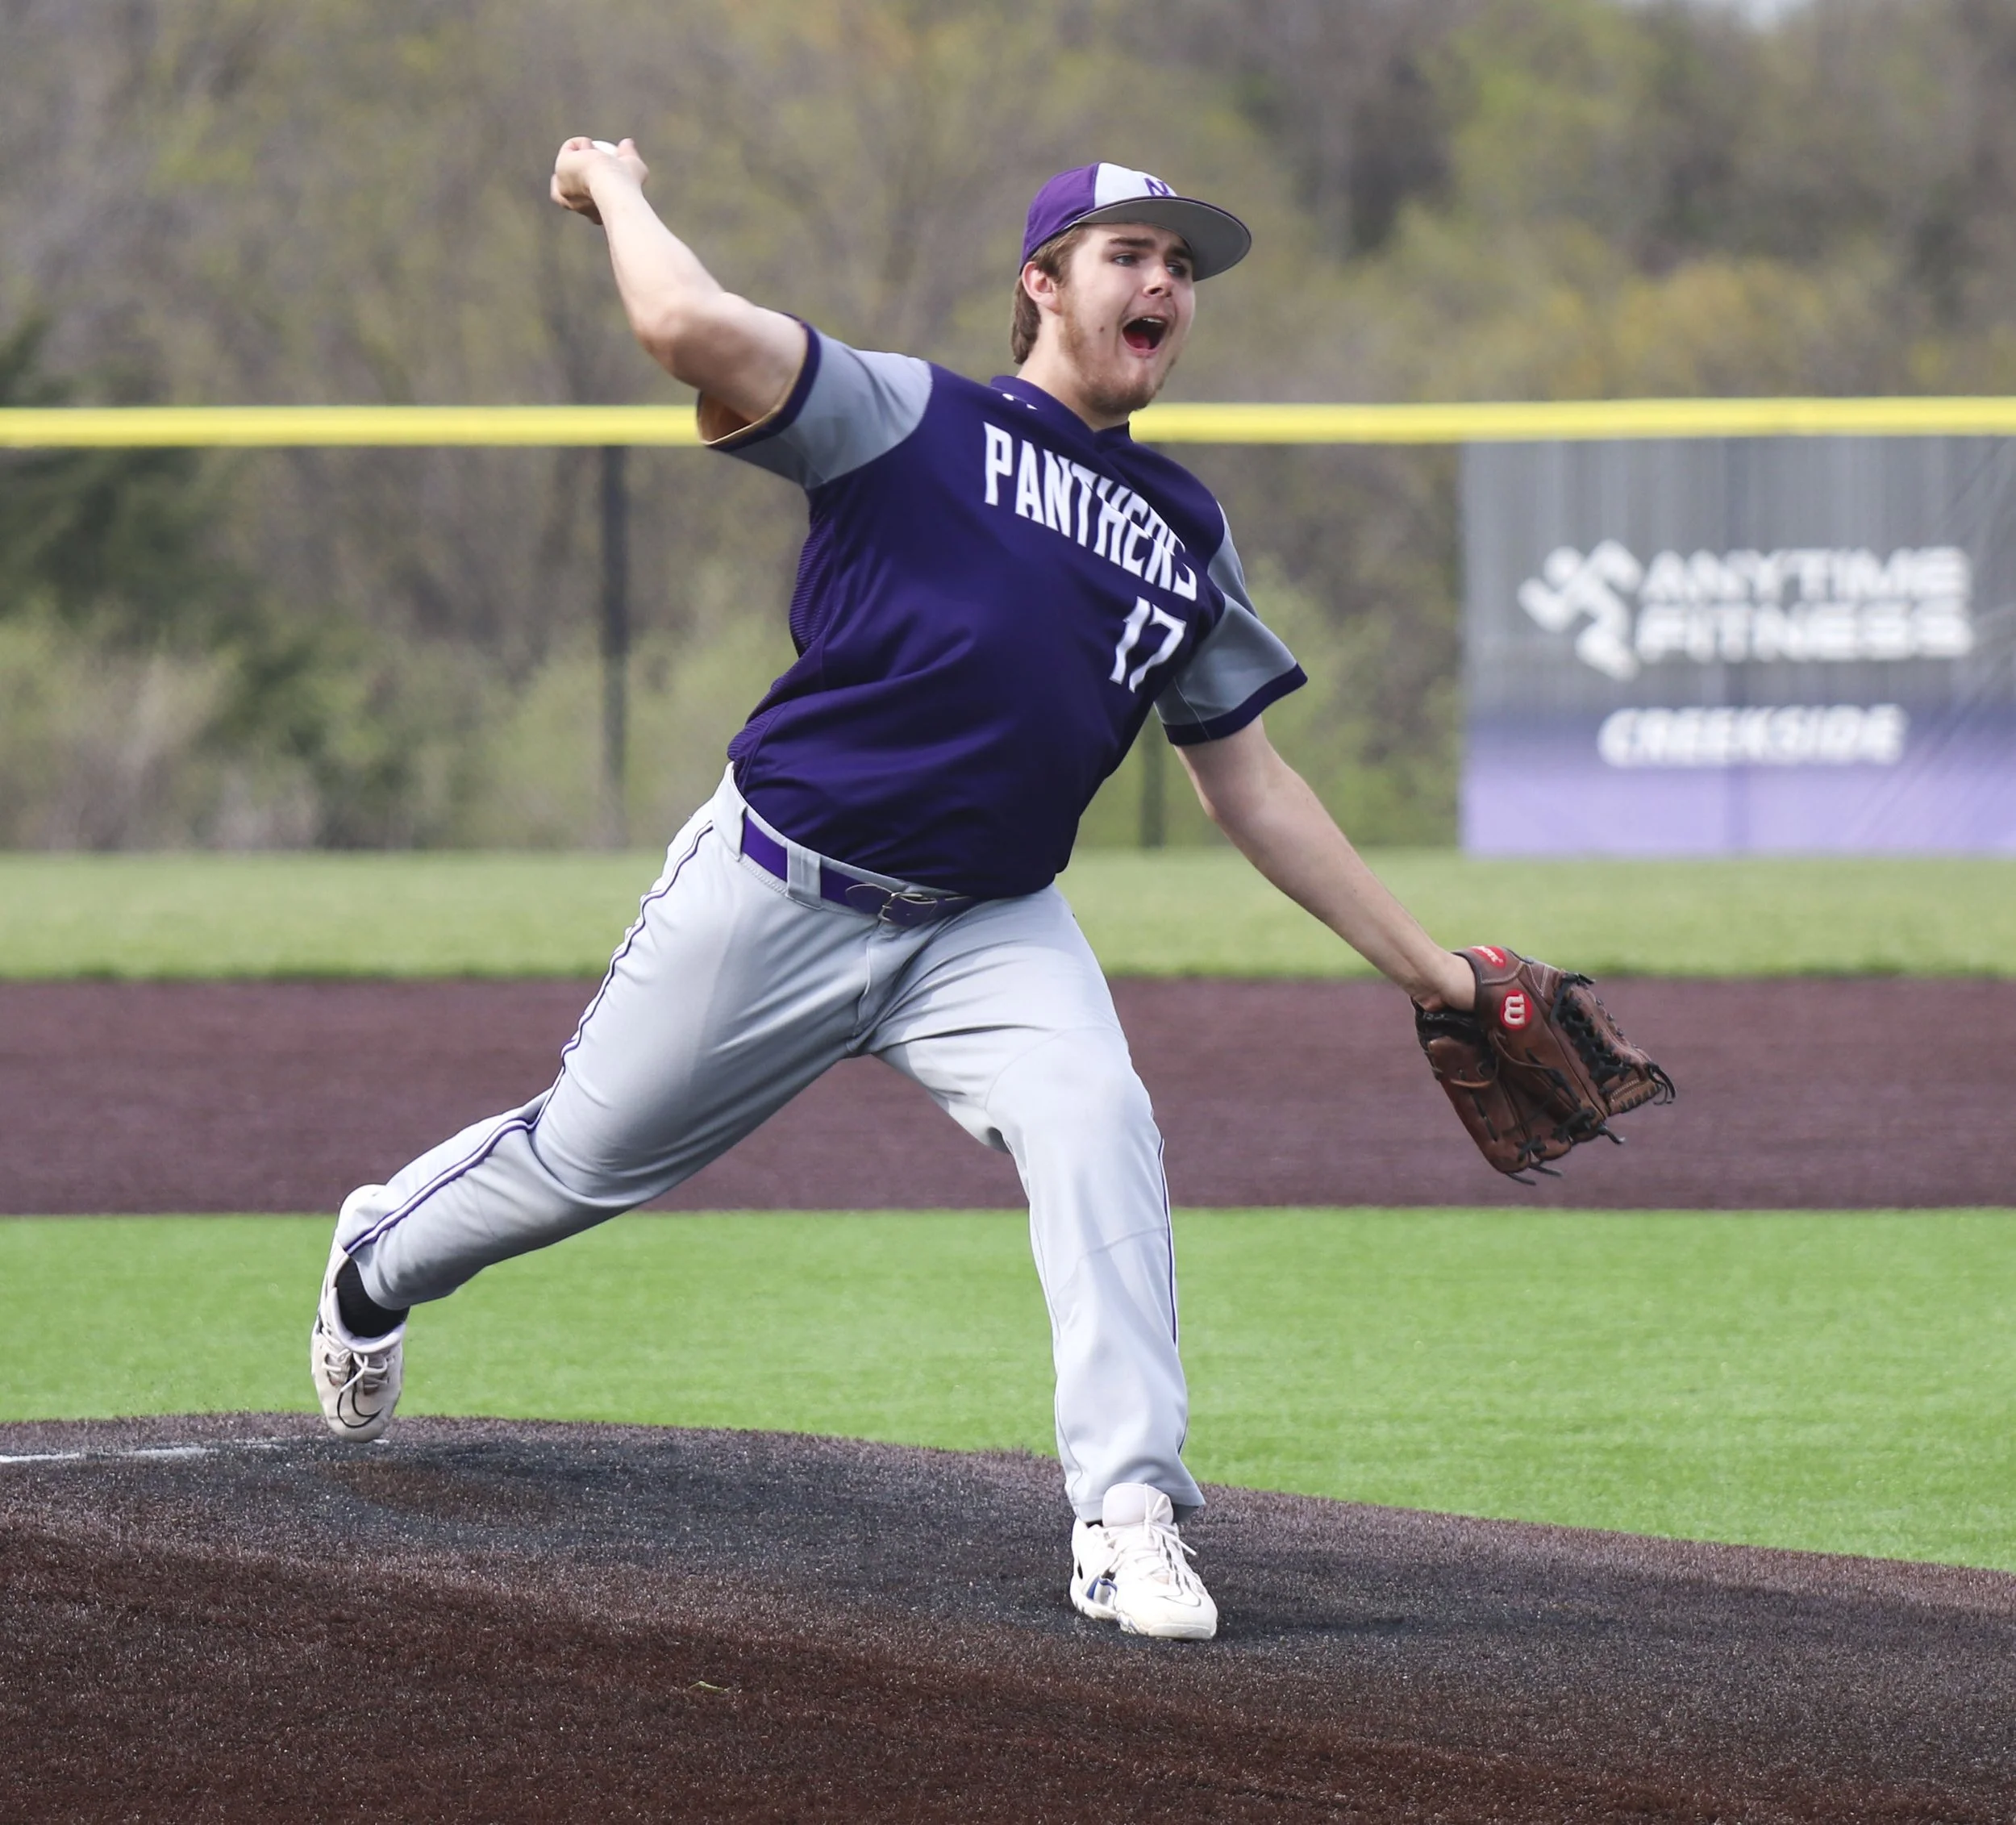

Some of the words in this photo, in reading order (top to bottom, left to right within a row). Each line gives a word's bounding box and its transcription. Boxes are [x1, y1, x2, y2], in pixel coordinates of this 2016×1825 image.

[983, 421, 1198, 601] PANTHERS
[1639, 548, 1971, 602] ANYTIME
[1109, 595, 1187, 694] 17
[1635, 601, 1972, 660] FITNESS
[1598, 705, 1907, 768] CREEKSIDE
